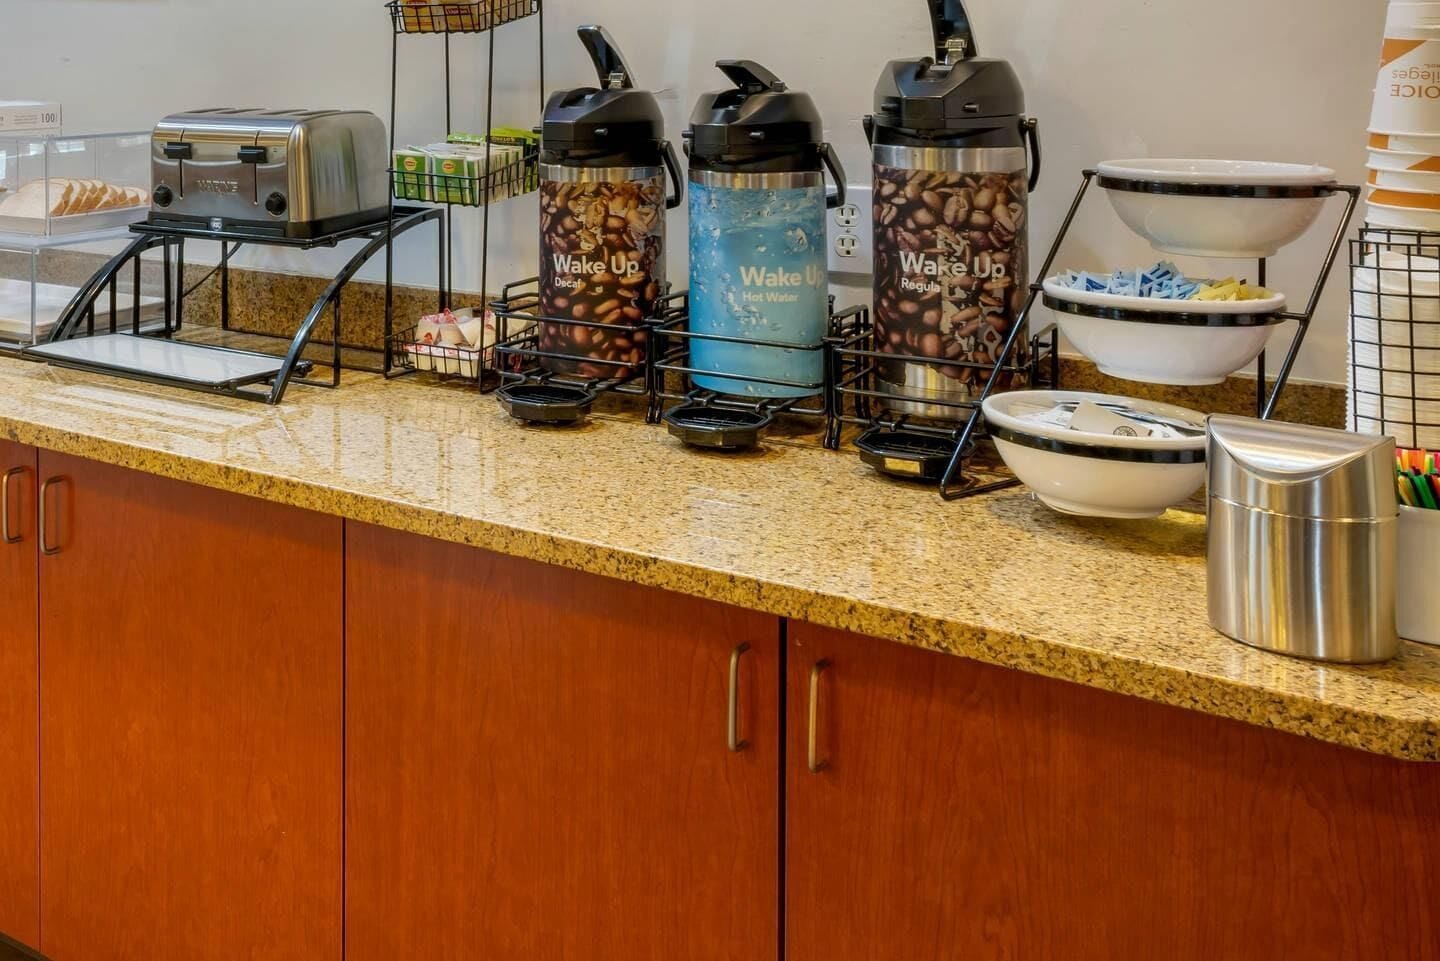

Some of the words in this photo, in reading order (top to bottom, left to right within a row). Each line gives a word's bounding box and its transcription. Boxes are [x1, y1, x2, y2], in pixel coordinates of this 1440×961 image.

[1391, 66, 1440, 84] ileges
[1390, 83, 1440, 99] OICE
[552, 253, 607, 274] Wake
[610, 255, 640, 278] Up
[899, 250, 968, 278] Wake
[973, 255, 1006, 283] Up
[554, 276, 582, 289] Decaf
[739, 266, 802, 287] Wake
[805, 264, 825, 289] Up
[901, 277, 942, 293] Regula
[742, 291, 765, 302] Hot
[766, 292, 800, 303] Water
